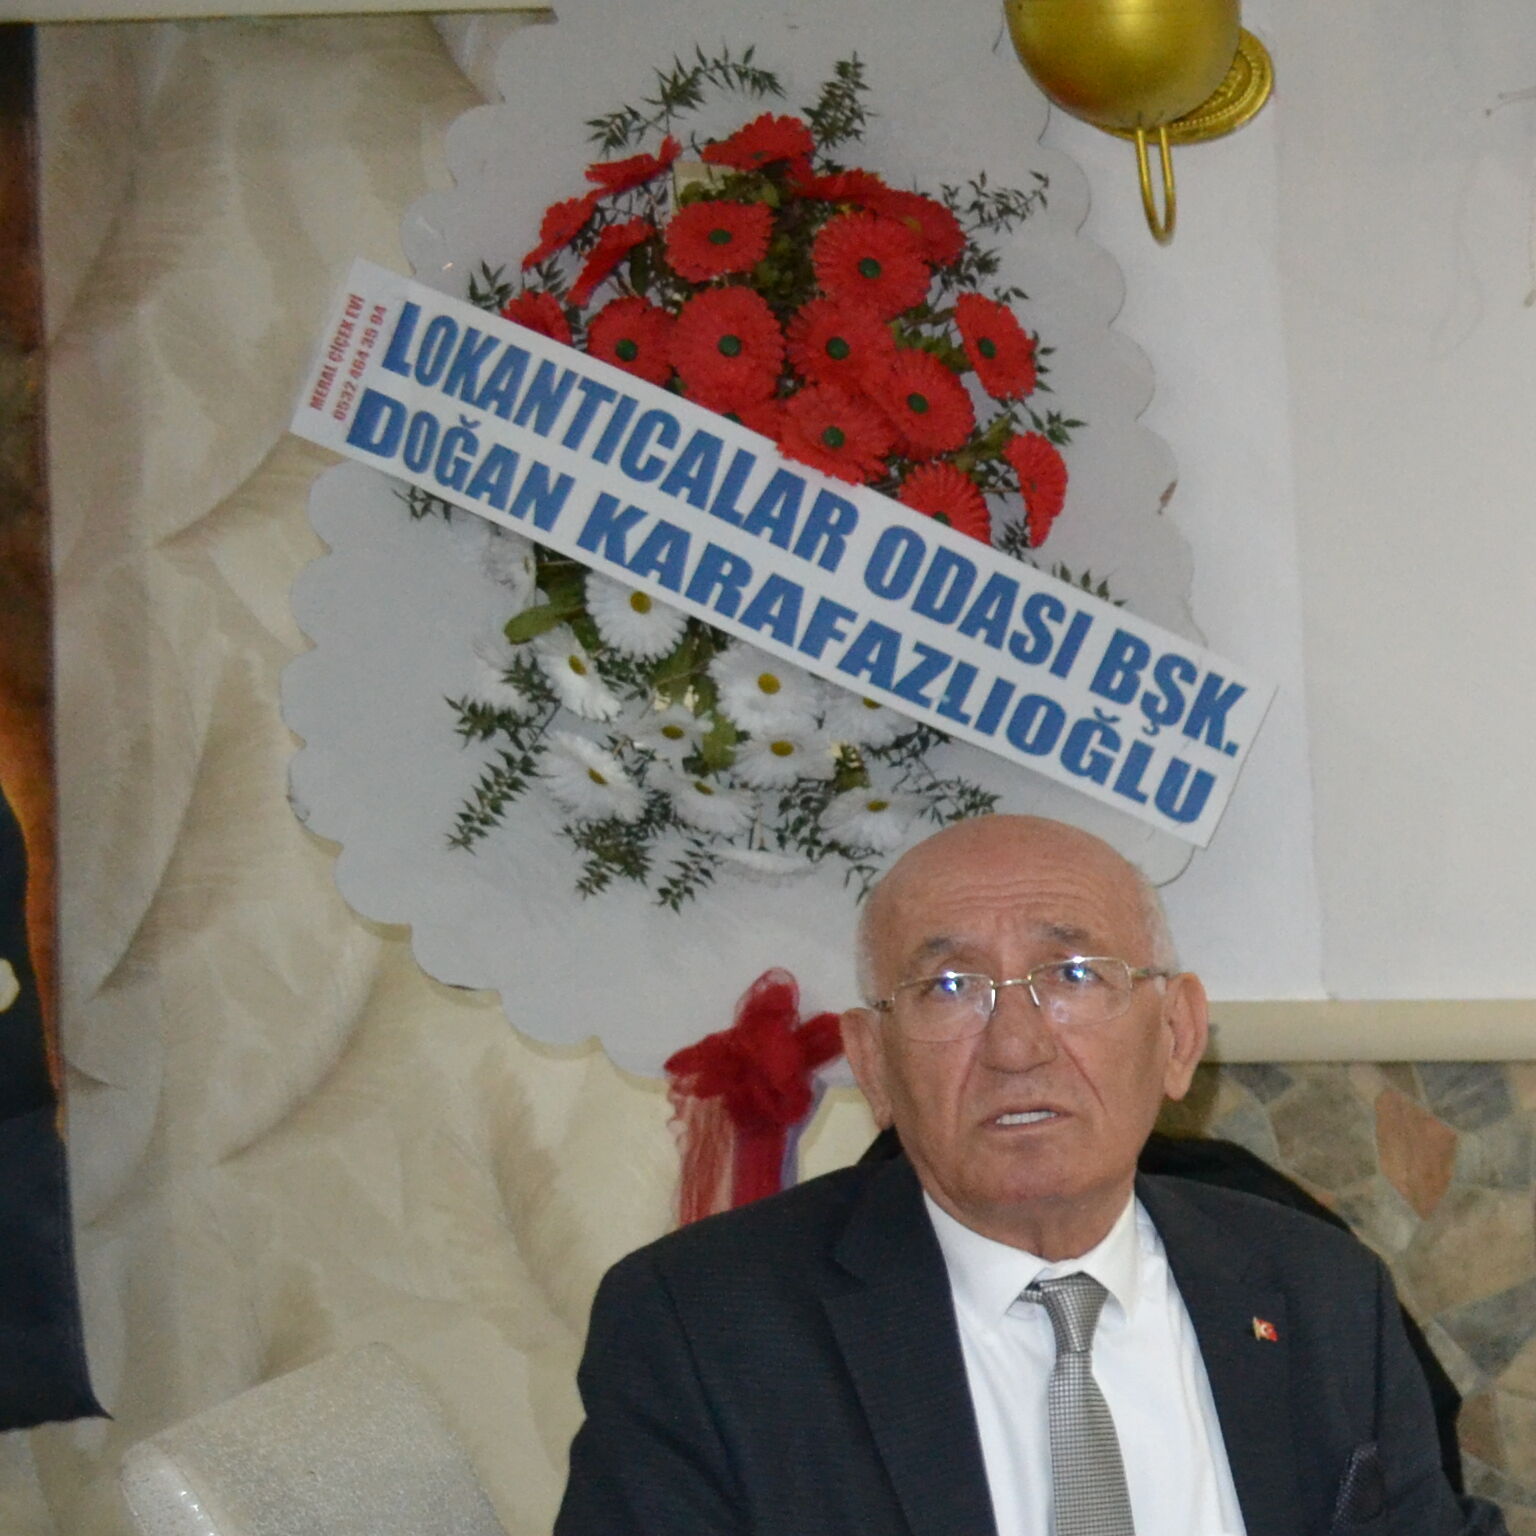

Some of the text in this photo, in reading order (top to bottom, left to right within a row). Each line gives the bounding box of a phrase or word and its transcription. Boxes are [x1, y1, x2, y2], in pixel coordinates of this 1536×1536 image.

[310, 364, 338, 411] MERAL
[333, 381, 357, 421] 0532
[346, 388, 1216, 823] DOĞAN KARAFAZLIOĞLU
[382, 302, 1247, 757] LOKANTICALAR ODASI BŞK.
